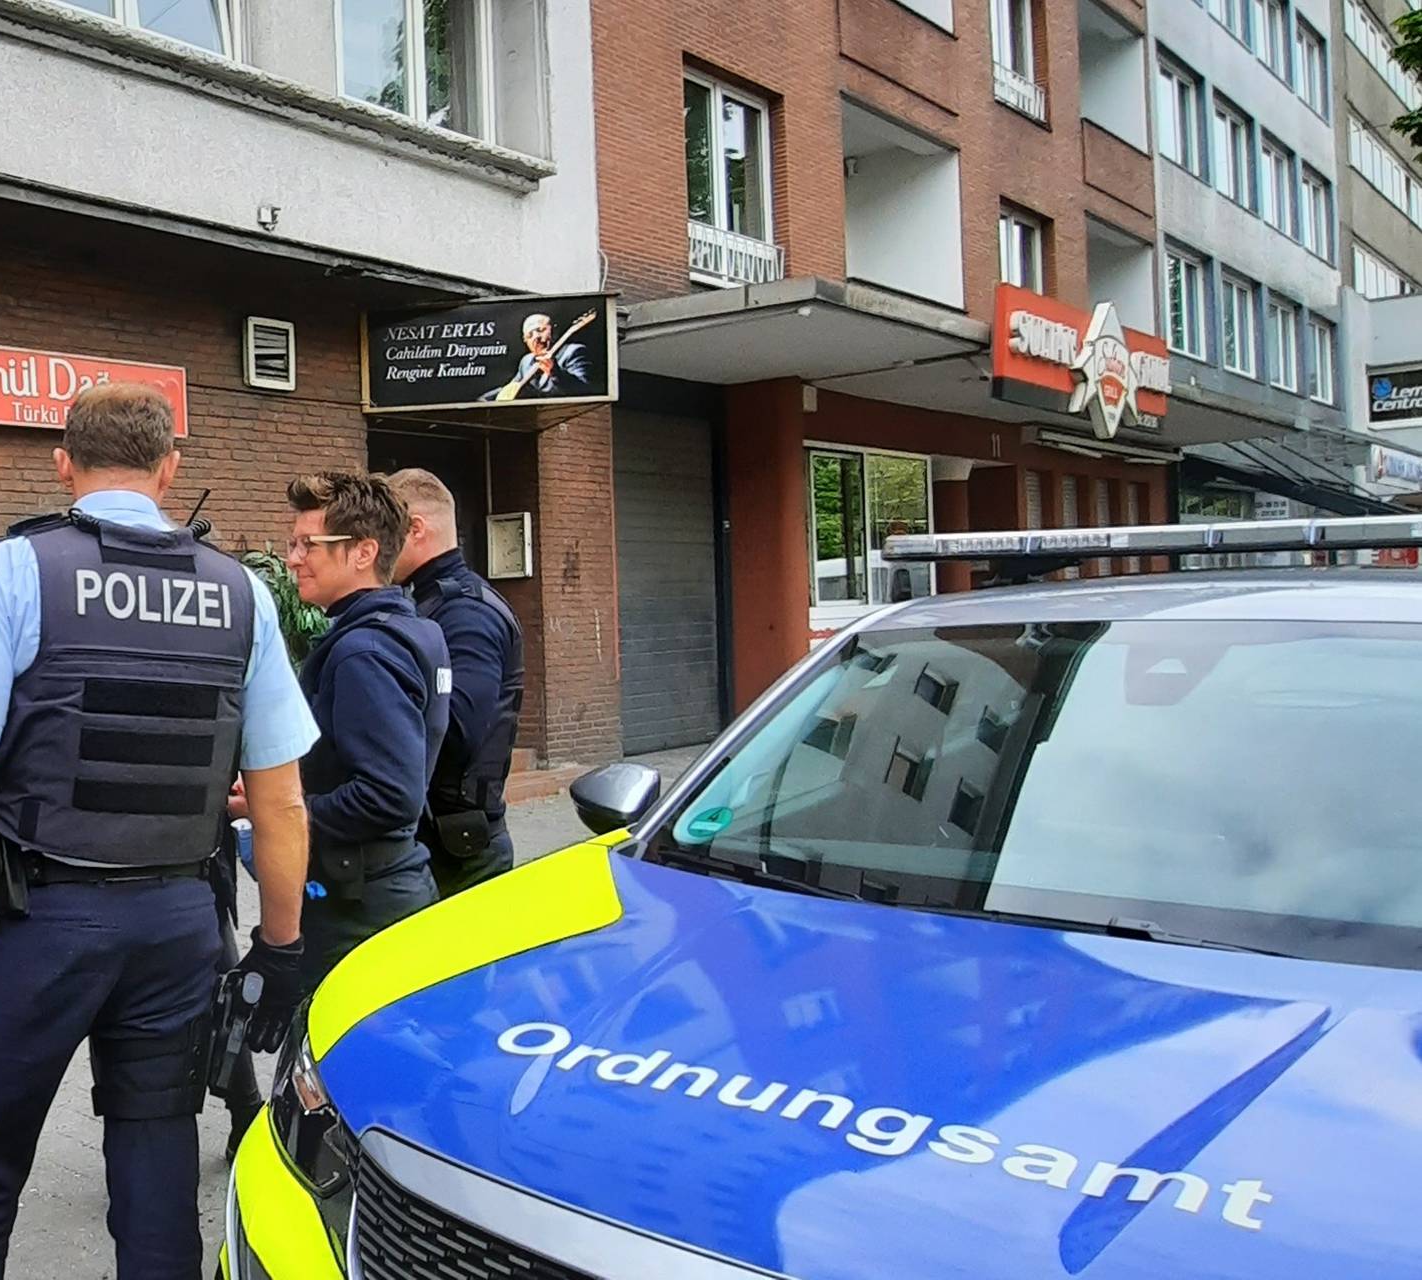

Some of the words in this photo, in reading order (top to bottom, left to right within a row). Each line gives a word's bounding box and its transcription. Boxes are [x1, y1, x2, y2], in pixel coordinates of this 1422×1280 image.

[383, 324, 440, 341] NESAT
[441, 321, 496, 339] ERTAS
[385, 364, 435, 383] Rengine
[12, 400, 59, 423] Türkü
[991, 433, 1002, 457] 11
[76, 569, 232, 629] POLIZEI
[497, 1021, 1274, 1230] Ordnungsamt
